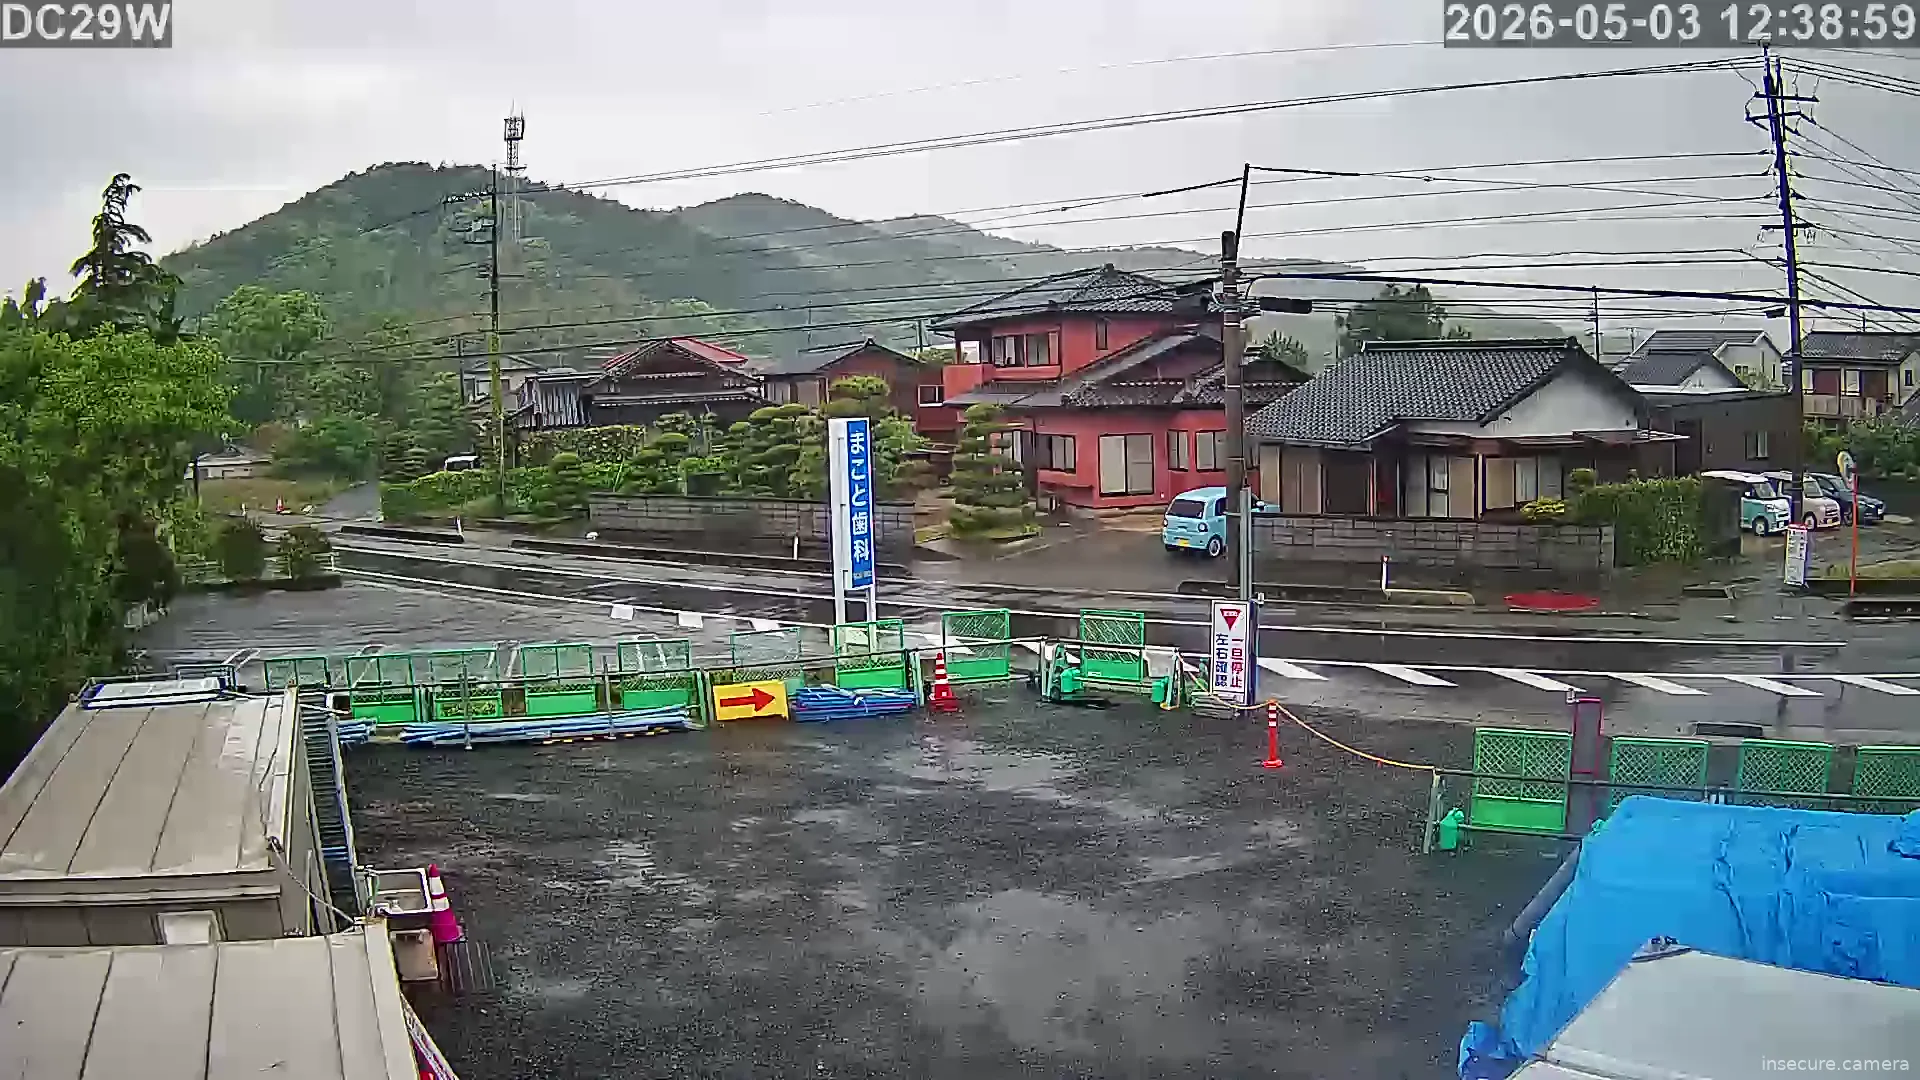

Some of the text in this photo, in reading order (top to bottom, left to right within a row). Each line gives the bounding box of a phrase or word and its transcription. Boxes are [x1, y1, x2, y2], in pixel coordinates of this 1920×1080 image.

[850, 430, 870, 563] まこと歯科
[1215, 632, 1229, 687] 左右確認
[1230, 637, 1244, 688] 一旦停止
